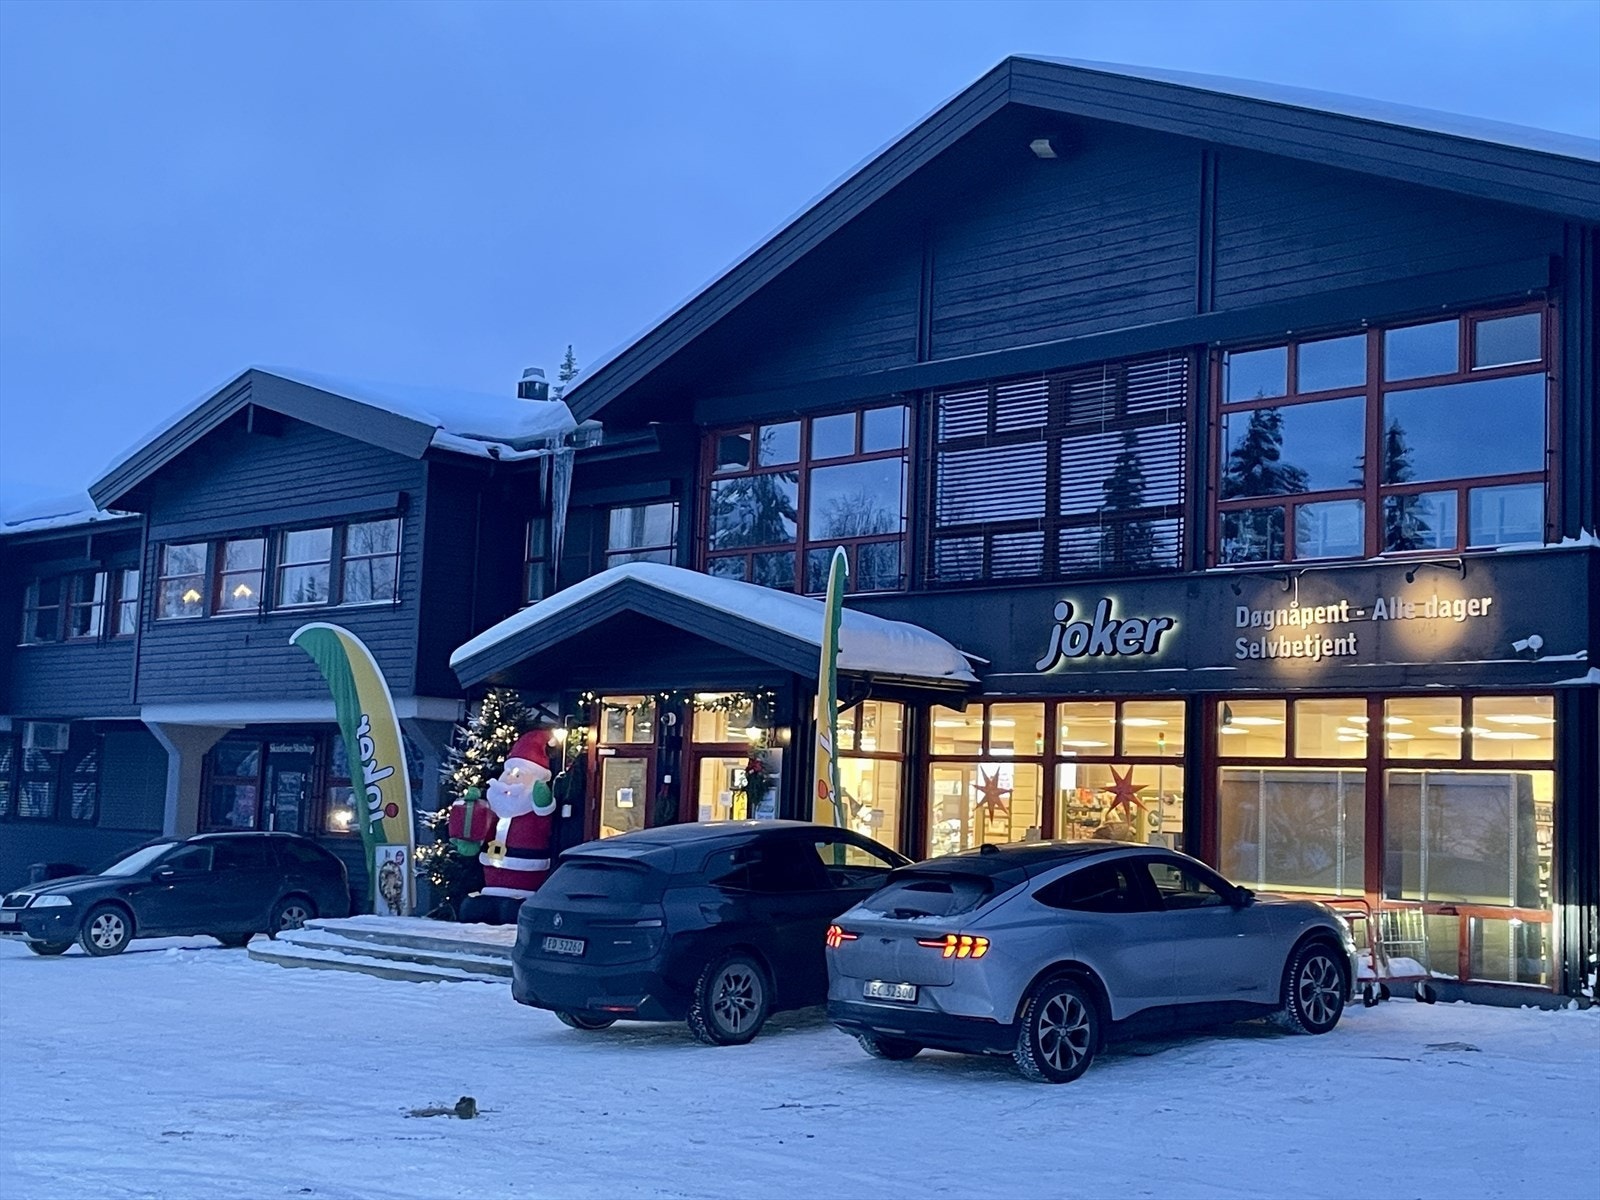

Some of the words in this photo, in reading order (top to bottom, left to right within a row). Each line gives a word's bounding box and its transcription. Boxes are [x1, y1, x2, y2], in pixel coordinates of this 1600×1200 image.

[1236, 600, 1349, 630] Døgnåpent
[1372, 597, 1415, 620] Alle
[1424, 595, 1492, 622] dager
[1036, 598, 1172, 671] joker
[1235, 633, 1357, 661] Selvbetjent
[871, 984, 884, 996] EC
[885, 985, 914, 999] 52300
